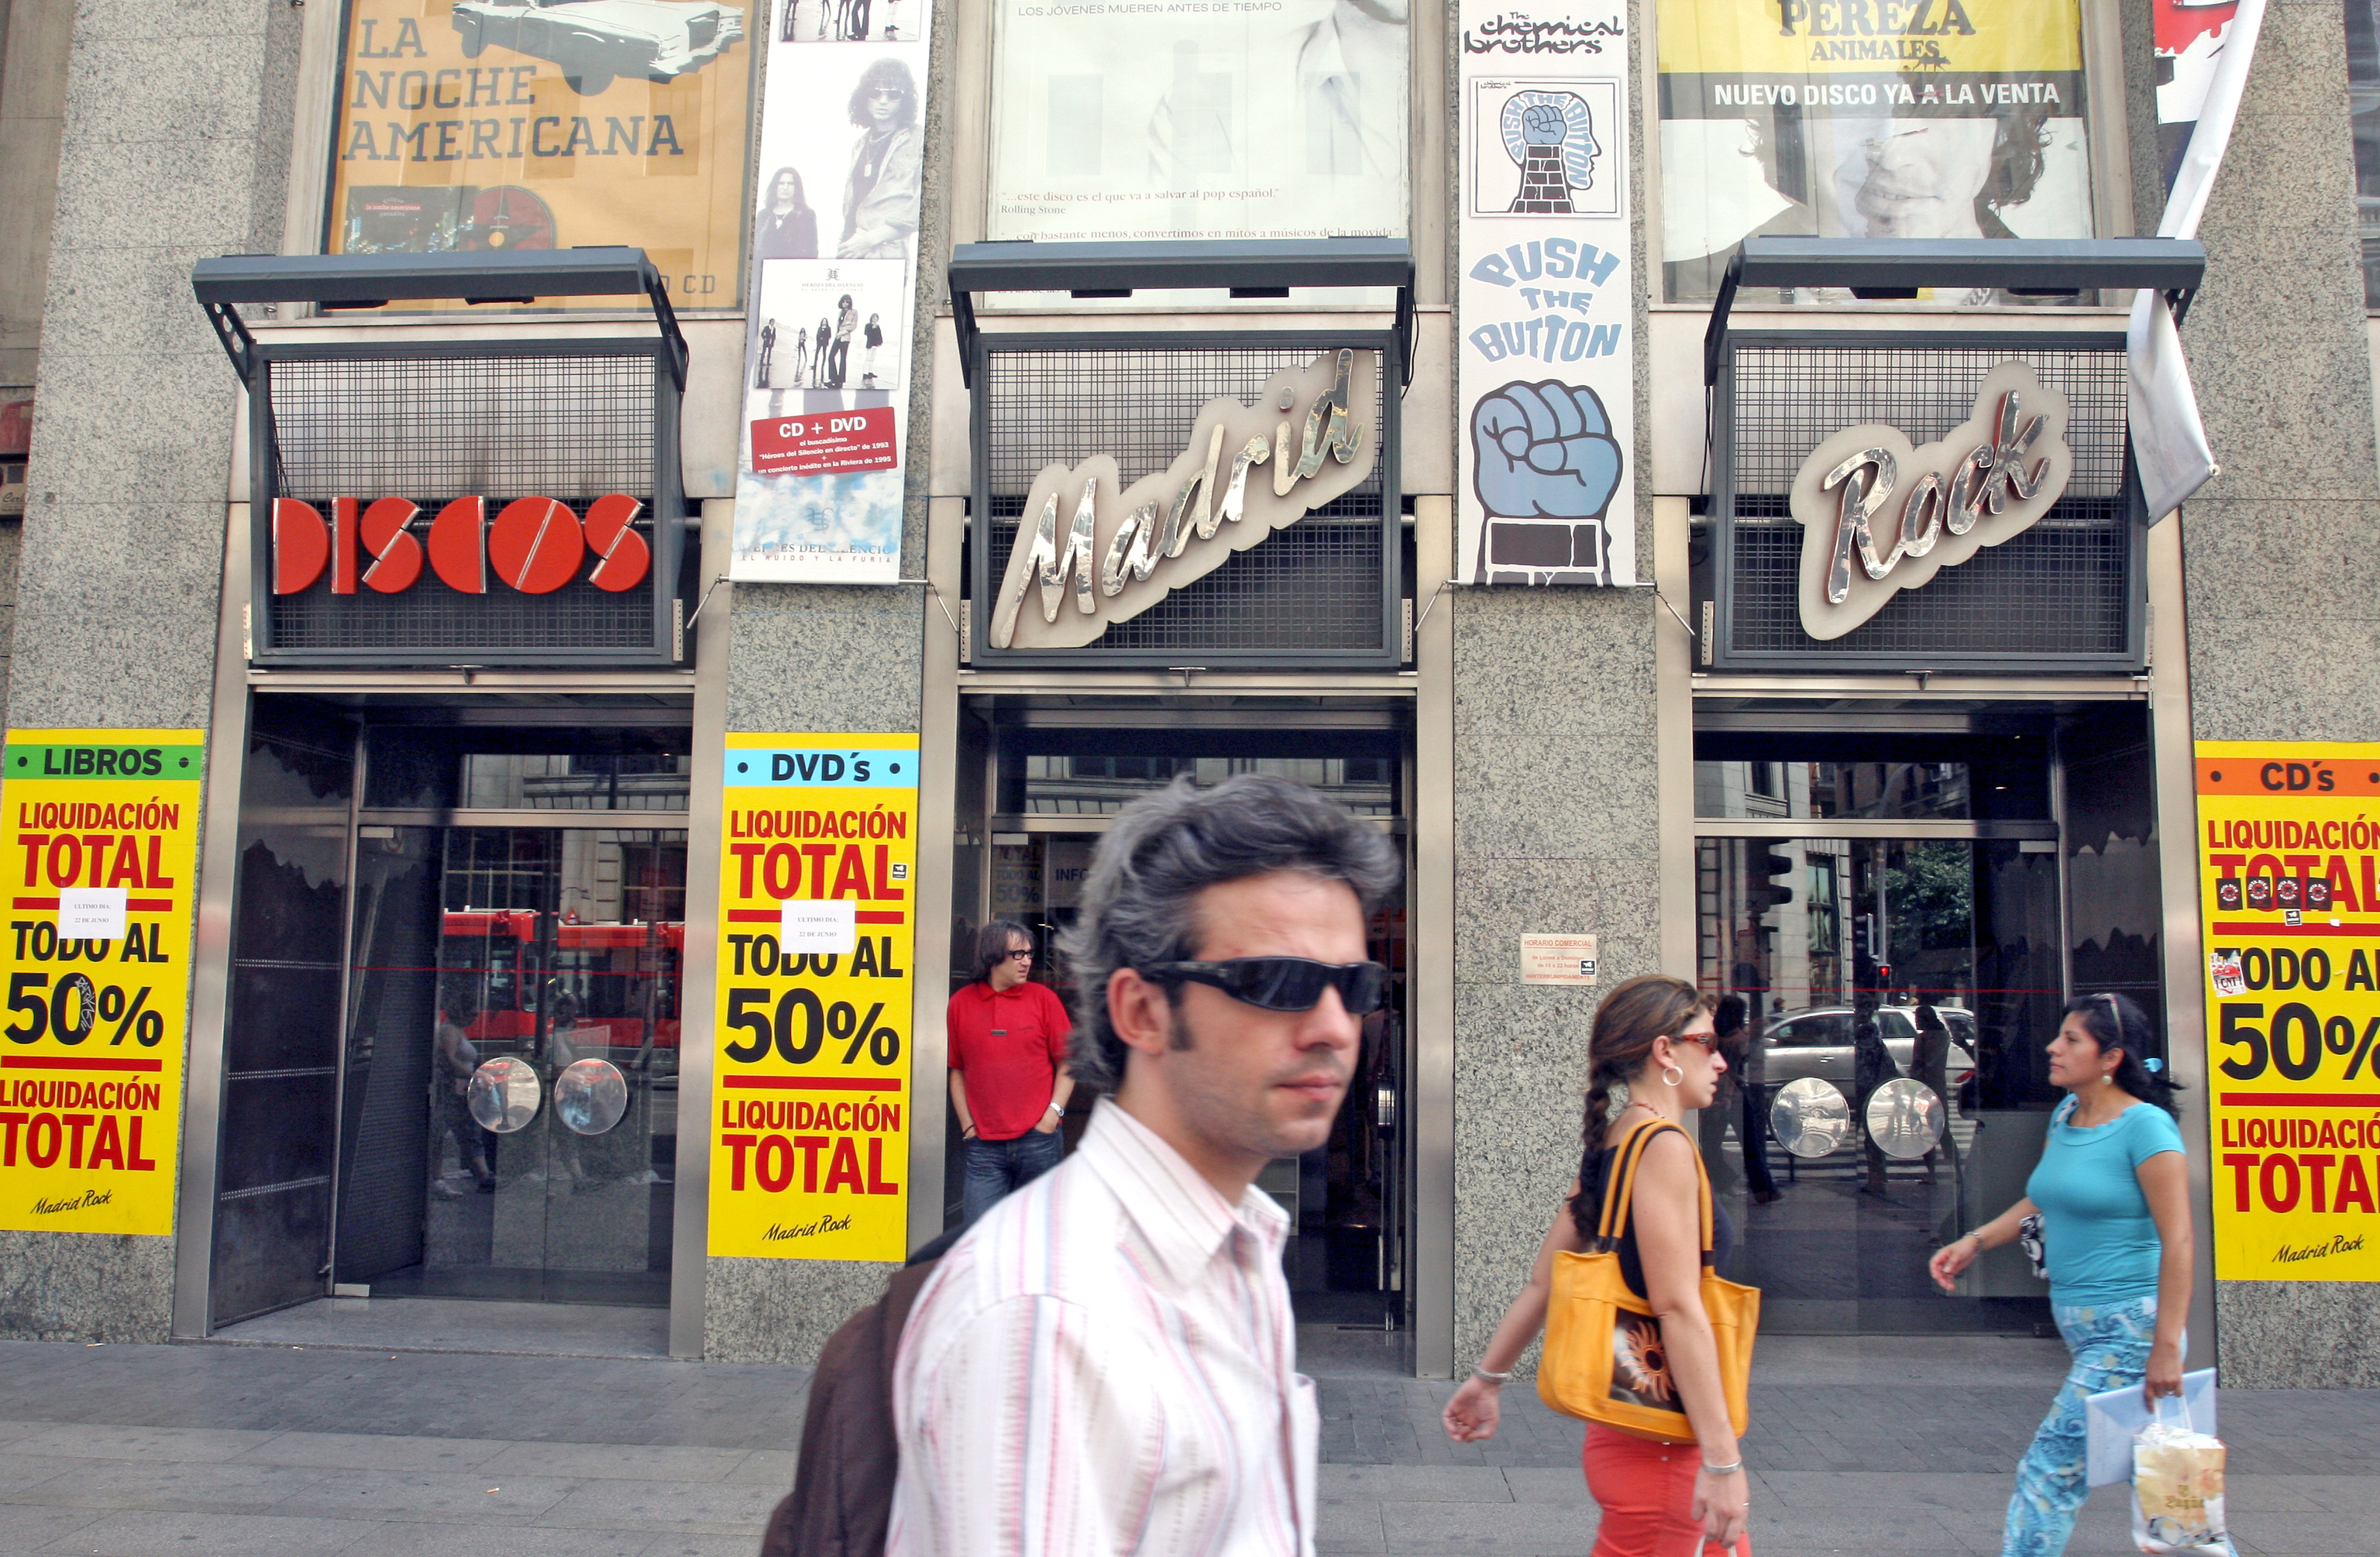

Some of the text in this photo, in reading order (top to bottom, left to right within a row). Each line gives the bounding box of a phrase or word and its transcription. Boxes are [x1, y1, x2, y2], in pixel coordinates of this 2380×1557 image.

[1018, 2, 1281, 16] LOS JÓVENES MUEREN ANTES DE TIEMPO
[1481, 15, 1624, 36] chemical
[1779, 0, 1976, 36] PEREZA
[358, 18, 427, 58] LA
[1464, 31, 1602, 54] brothers
[1810, 40, 1941, 61] ANIMALES
[351, 65, 537, 110] NOCHE
[1714, 83, 2061, 106] NUEVO DISCO YA A LA VENTA
[342, 114, 684, 162] AMERICANA
[1503, 93, 1593, 186] PUSH THE BUTTON
[1001, 205, 1066, 215] Rolling Stone
[1044, 191, 1073, 201] disco
[1077, 193, 1089, 201] es
[1092, 192, 1102, 201] el
[1105, 193, 1126, 203] que
[1154, 191, 1186, 199] salvar
[1190, 190, 1199, 198] al
[1203, 191, 1225, 201] pop
[1040, 231, 1087, 240] bastante
[1091, 230, 1131, 239] menos,
[1133, 229, 1204, 238] convertimos
[1270, 228, 1316, 238] músicos
[1320, 228, 1333, 237] de
[1338, 227, 1346, 236] la
[1469, 238, 1621, 287] PUSH
[683, 275, 716, 294] CD
[1519, 287, 1594, 316] THE
[1469, 314, 1622, 364] BUTTON
[779, 416, 867, 438] CD + DVD
[799, 462, 821, 470] inédito
[999, 348, 1364, 648] Madrid
[1821, 390, 2053, 604] Rock
[273, 493, 651, 594] DISCOS
[799, 544, 825, 553] DEL
[44, 748, 163, 775] LIBROS
[19, 796, 179, 830] LIQUIDACIÓN
[731, 803, 906, 839] LIQUIDACIÓN
[2208, 813, 2380, 850] LIQUIDACIÓ
[18, 833, 174, 888] TOTAL
[730, 843, 904, 900] TOTAL
[2210, 854, 2380, 912] TOTAL
[12, 921, 169, 963] TODO AL
[727, 934, 903, 978] TODO AL
[2344, 948, 2380, 991] A
[4, 972, 164, 1047] 50%
[724, 988, 899, 1066] 50%
[2219, 1002, 2380, 1081] 50%
[0, 1075, 160, 1111] LIQUIDACIÓN
[722, 1095, 900, 1132] LIQUIDACIÓN
[2221, 1112, 2380, 1149] LIQUIDACIÓ
[0, 1112, 156, 1171] TOTAL
[721, 1134, 899, 1195] TOTAL
[30, 1189, 113, 1215] Madrid Rock
[2223, 1153, 2380, 1214] TOTA
[762, 1214, 852, 1242] Madrid Rock
[2272, 1234, 2365, 1263] Madrid Rock
